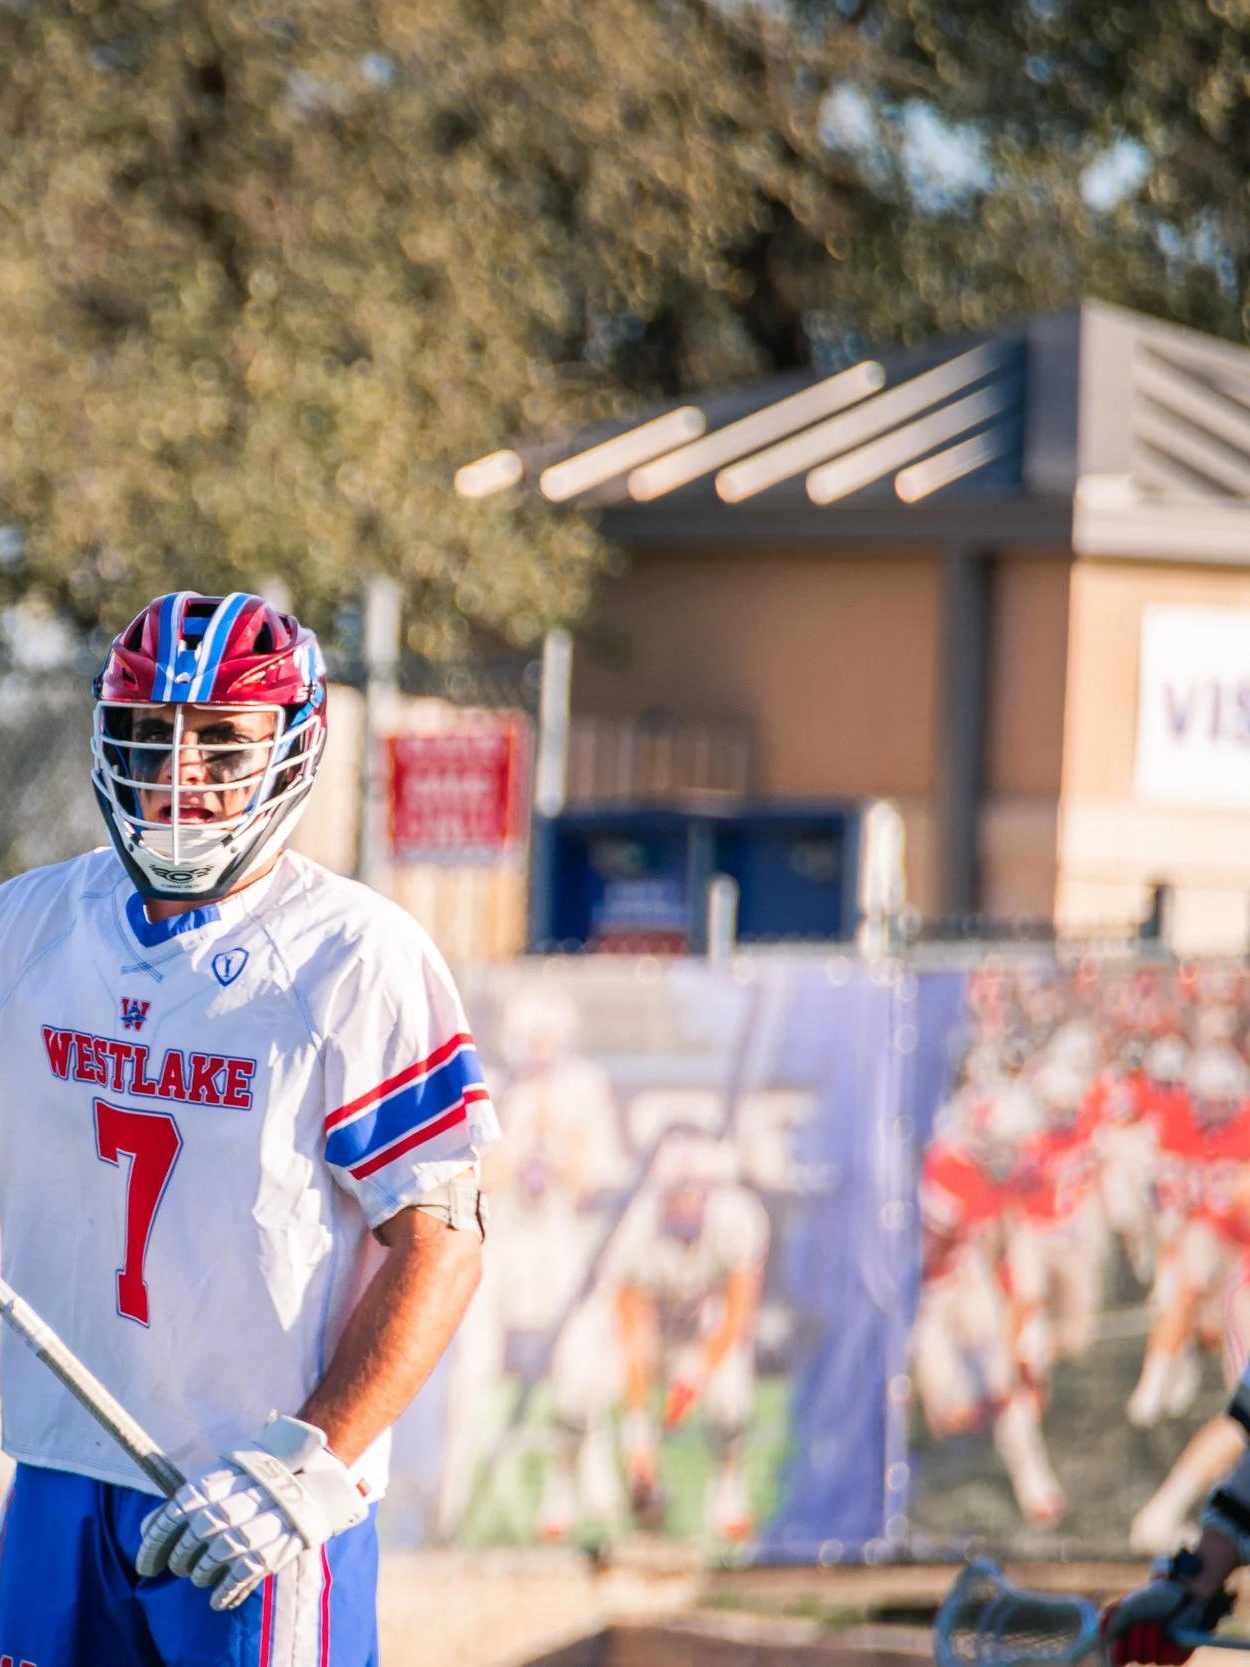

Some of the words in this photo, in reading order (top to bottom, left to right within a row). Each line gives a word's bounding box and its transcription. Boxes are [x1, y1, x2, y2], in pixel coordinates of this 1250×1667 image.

[120, 996, 150, 1031] W
[42, 1024, 257, 1110] WESTLAKE
[92, 1097, 183, 1328] 7
